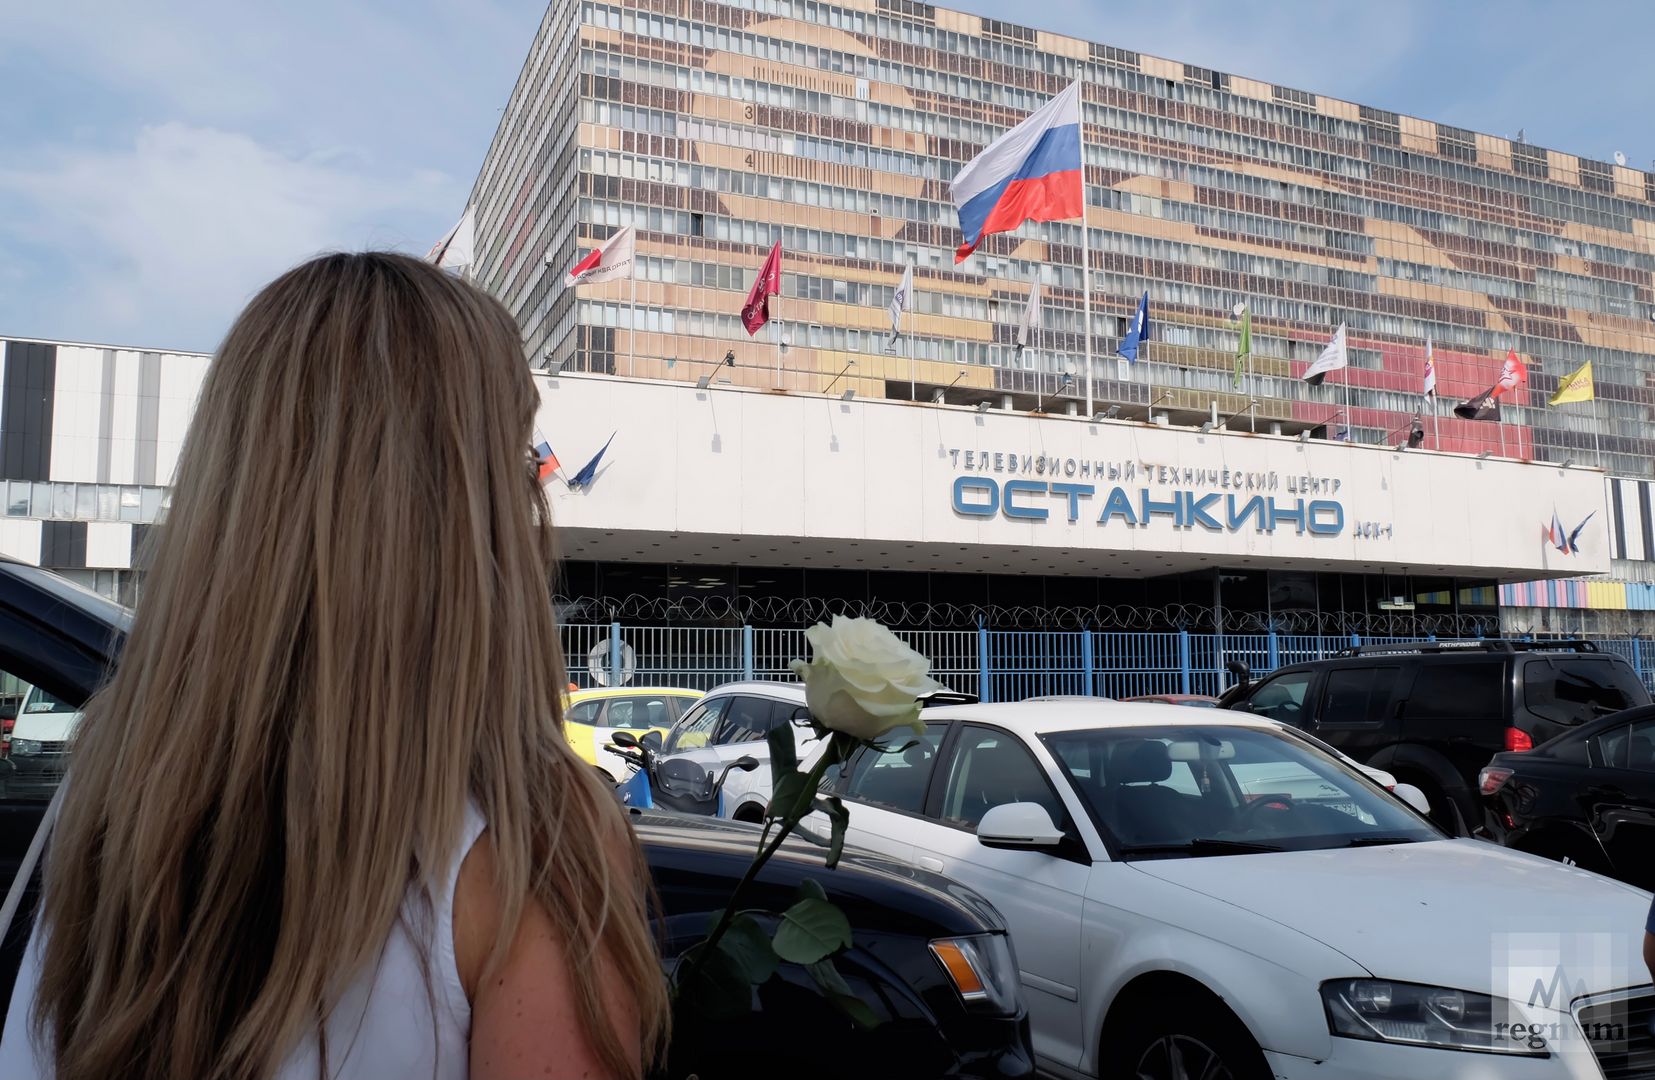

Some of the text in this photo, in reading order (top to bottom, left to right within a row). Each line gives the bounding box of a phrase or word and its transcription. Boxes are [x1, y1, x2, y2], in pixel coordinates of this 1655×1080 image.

[744, 105, 754, 120] 3
[744, 153, 754, 168] 4
[949, 449, 1342, 496] ТЕЛЕВИЗИОННЫЙ ТЕХНИЧЕСКИЙ ЦЕНТР
[953, 476, 1345, 535] ОСТАНКИНО
